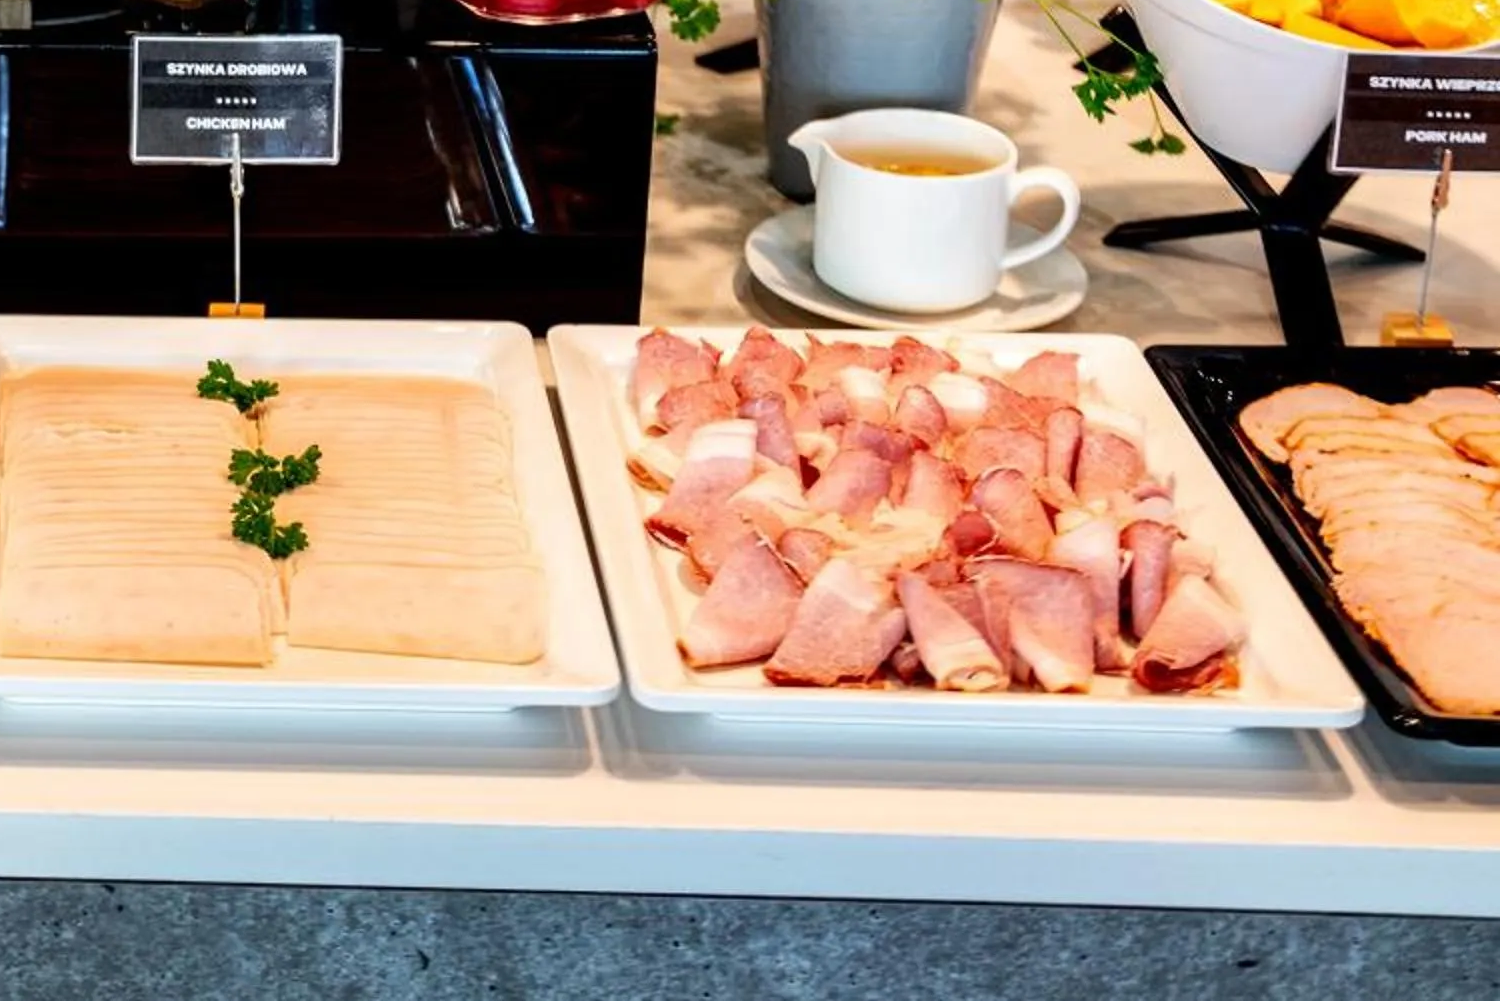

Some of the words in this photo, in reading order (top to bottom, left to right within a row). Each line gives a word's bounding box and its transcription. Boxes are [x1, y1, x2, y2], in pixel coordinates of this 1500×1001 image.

[167, 63, 225, 76] SZYNKA
[227, 64, 308, 76] DROBIOWA
[1369, 76, 1433, 90] SZYNKA
[186, 117, 250, 130] CHICKEN
[252, 118, 286, 130] HAM
[1405, 130, 1448, 143] PORK
[1449, 132, 1487, 144] HAM
